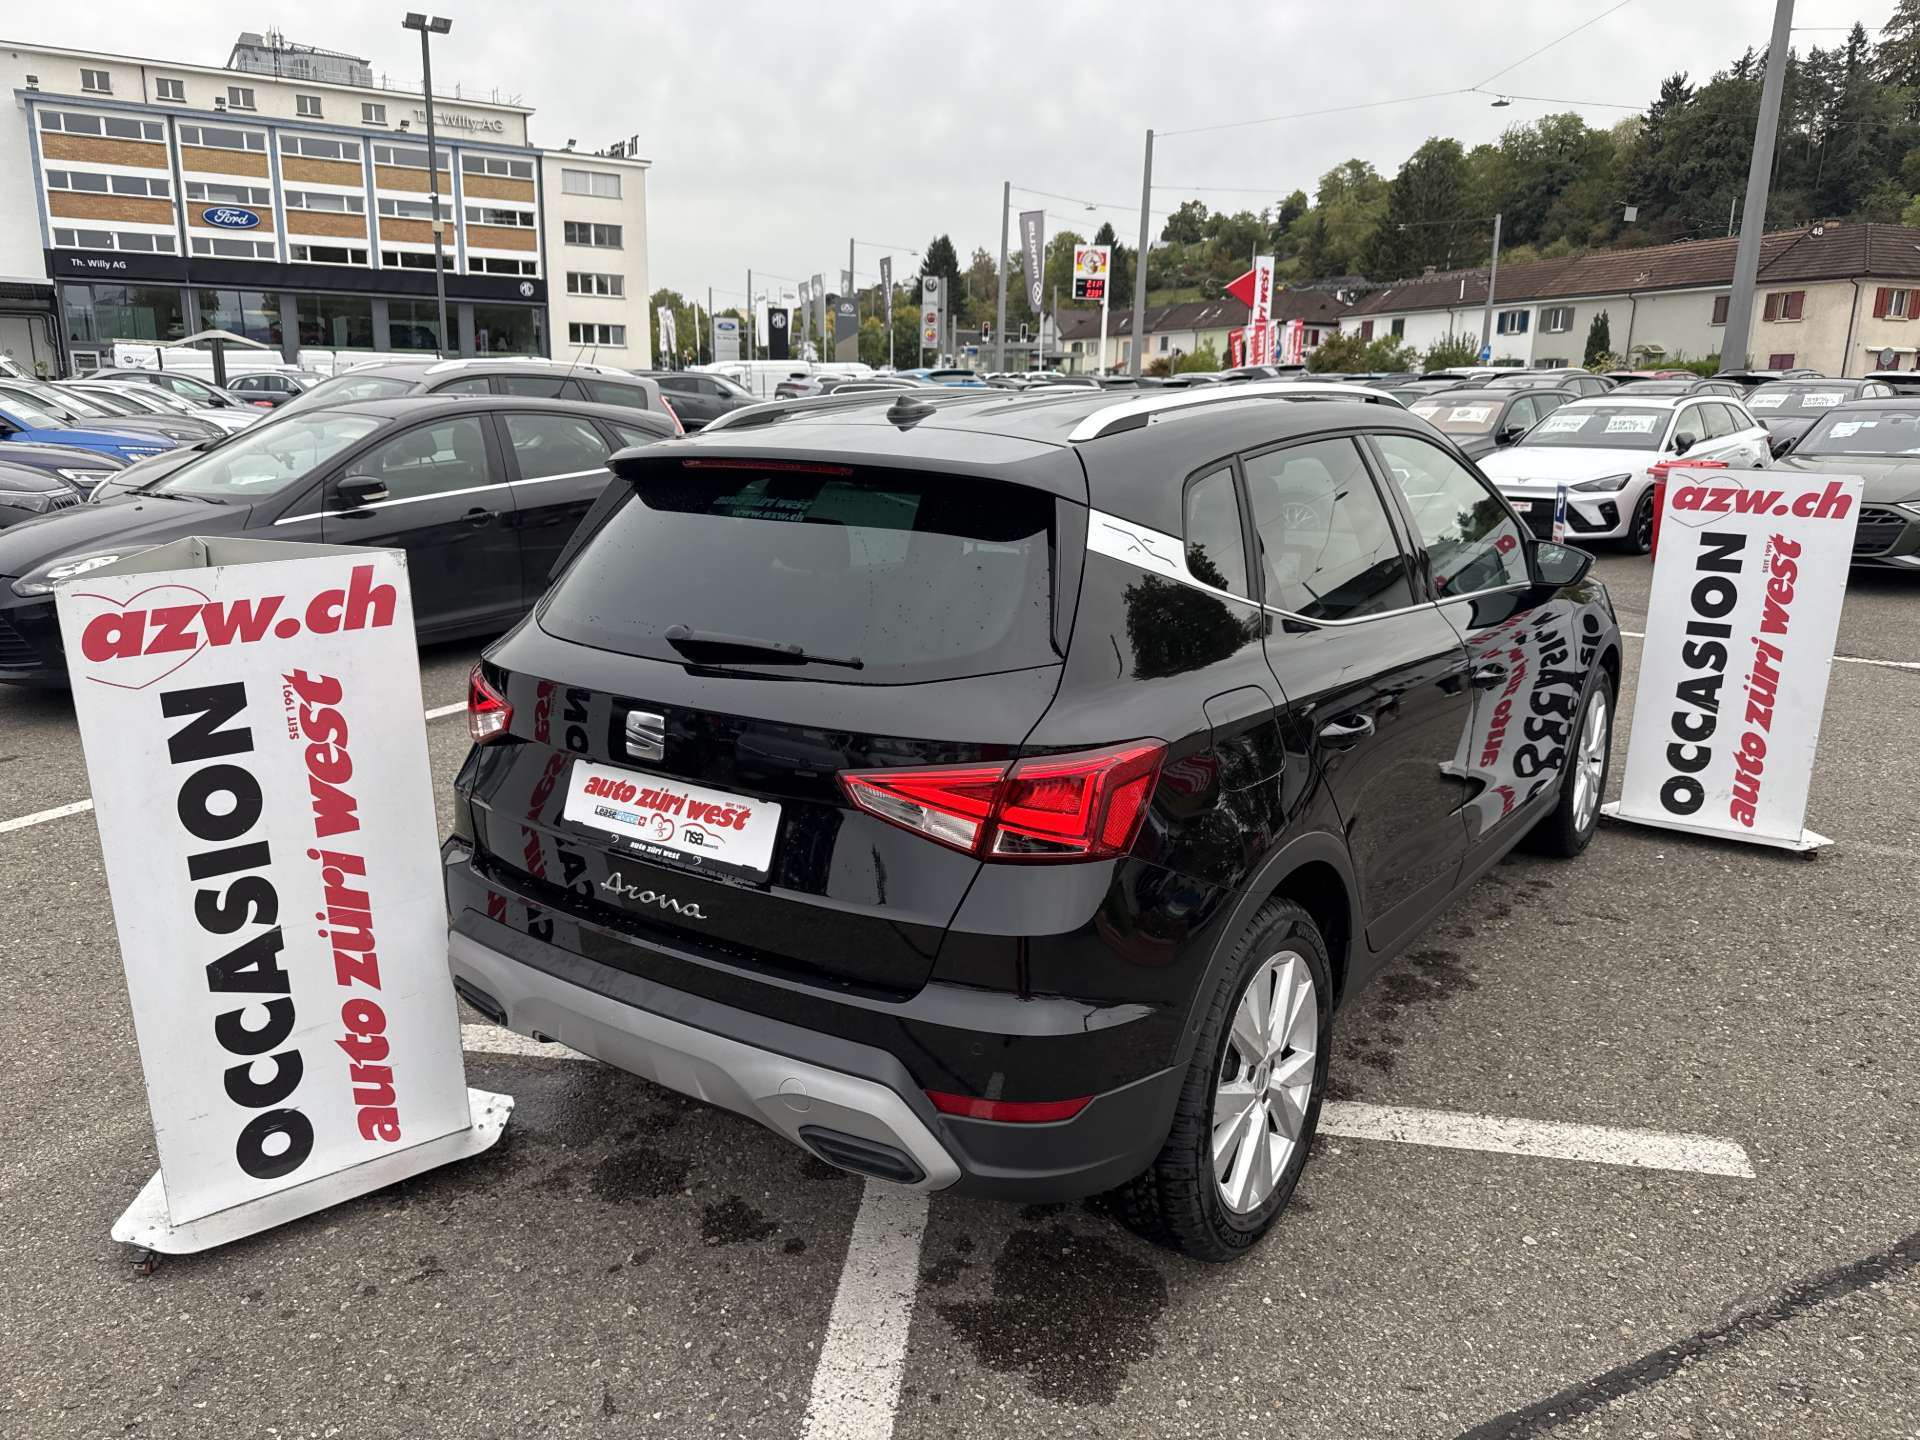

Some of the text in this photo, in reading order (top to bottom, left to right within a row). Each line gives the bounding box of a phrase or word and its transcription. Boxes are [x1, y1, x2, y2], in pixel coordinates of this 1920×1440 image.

[442, 113, 477, 131] Willy
[481, 119, 504, 133] AG
[210, 207, 252, 227] Ford
[1812, 227, 1824, 236] 48
[71, 258, 127, 271] Th. Willy AG
[1556, 491, 1564, 517] P
[1671, 481, 1853, 520] azw.ch
[81, 564, 397, 663] azw.ch
[1659, 531, 1747, 816] OCCASION
[1730, 533, 1801, 828] auto züri west
[282, 684, 300, 740] SEIT 1991
[584, 776, 752, 831] auto züri west
[629, 840, 681, 860] auto züri west
[683, 828, 705, 846] nsa
[281, 668, 402, 1143] auto züri west
[600, 871, 708, 919] Arona
[160, 681, 315, 1180] OCCASION
